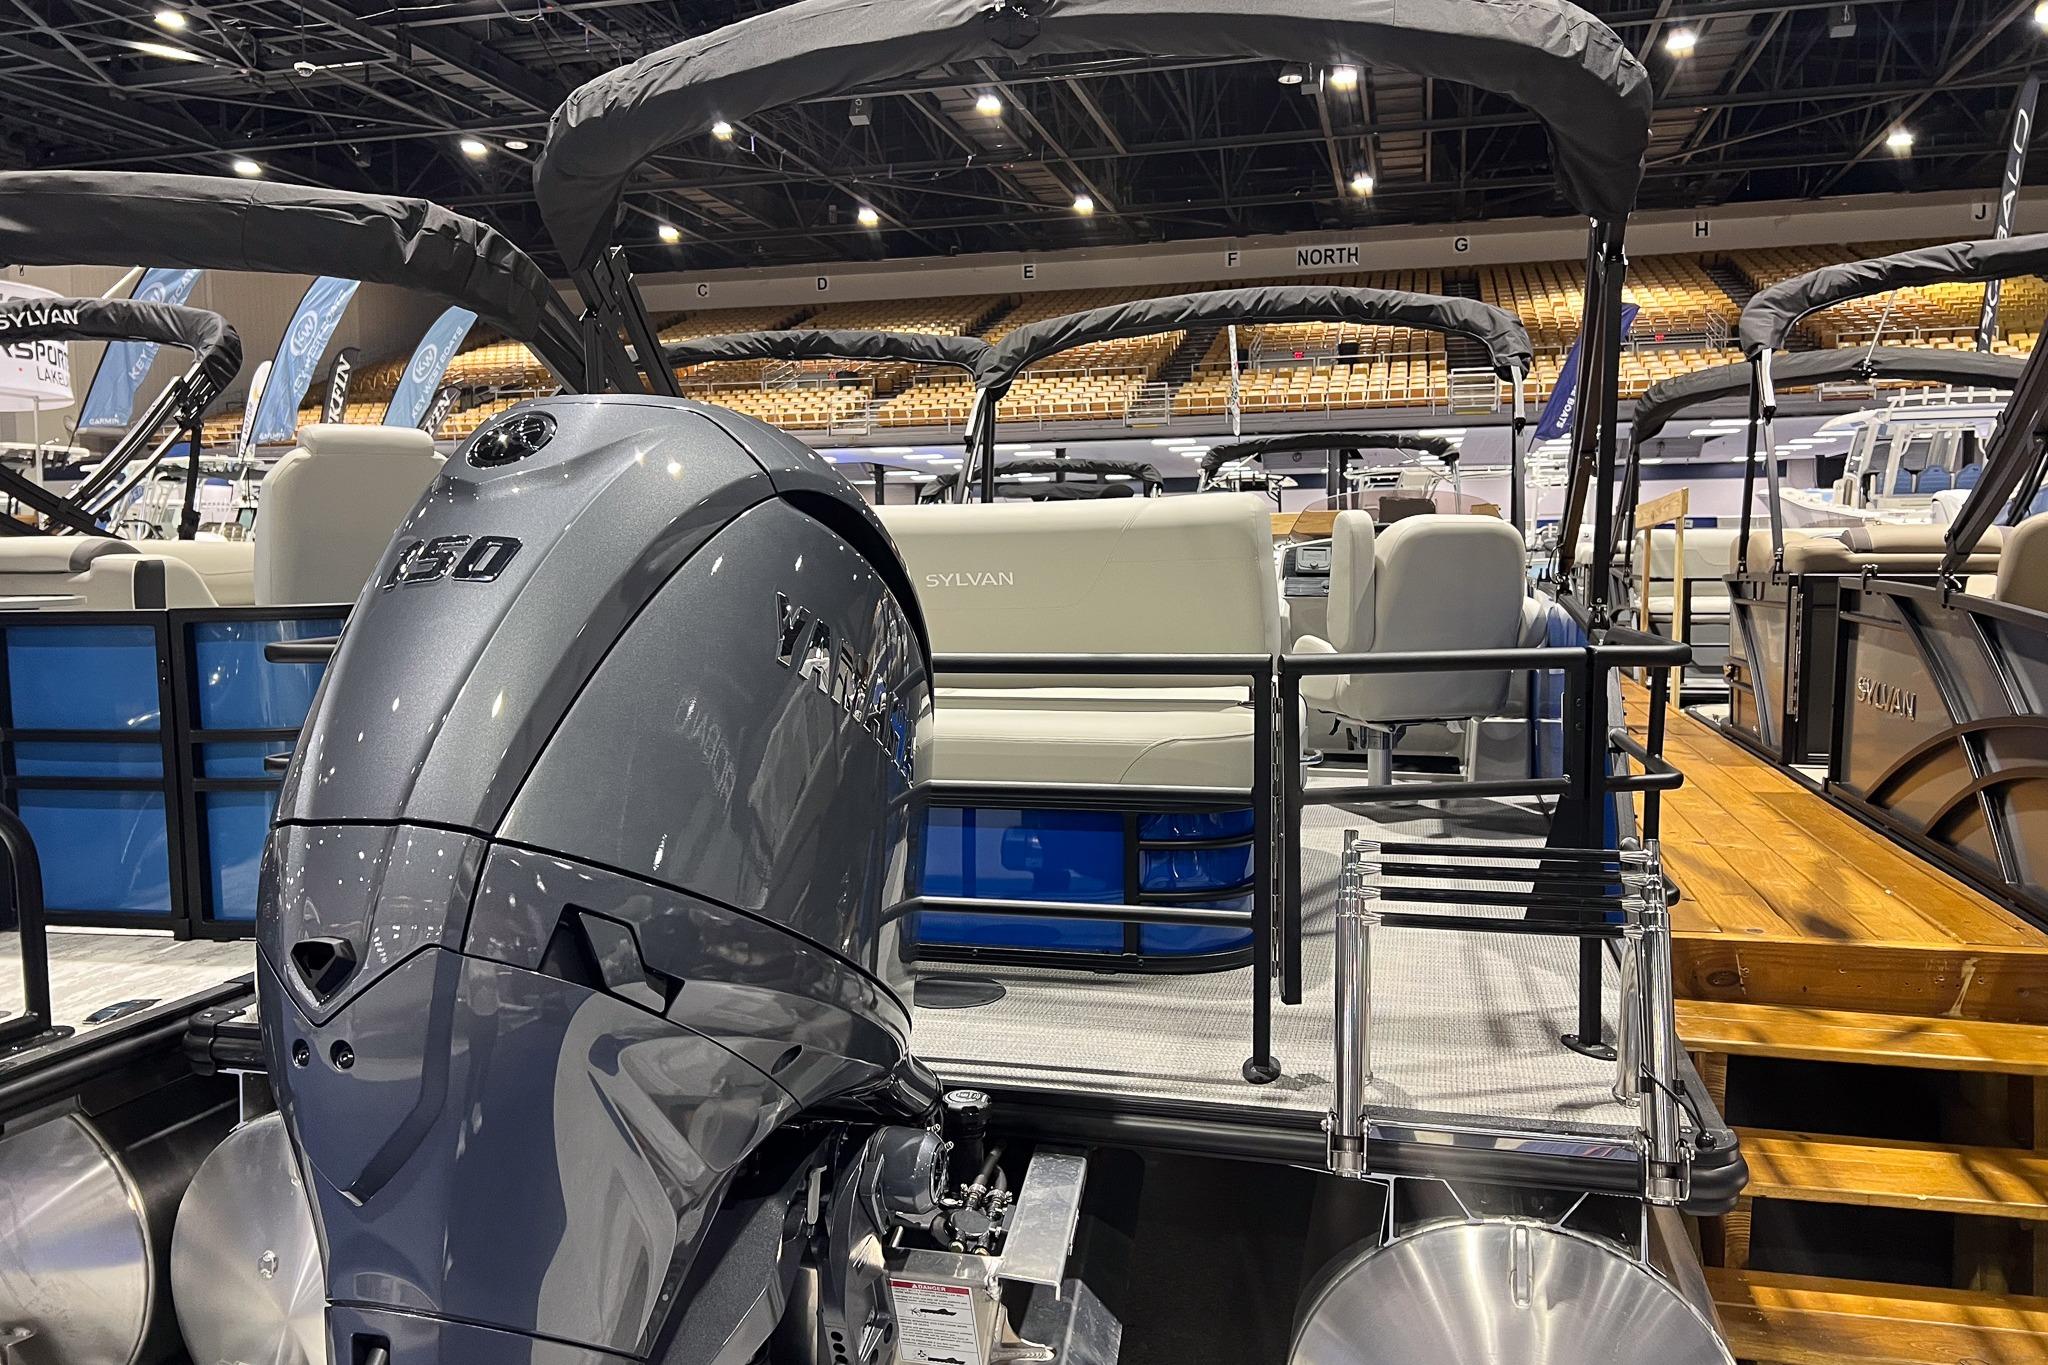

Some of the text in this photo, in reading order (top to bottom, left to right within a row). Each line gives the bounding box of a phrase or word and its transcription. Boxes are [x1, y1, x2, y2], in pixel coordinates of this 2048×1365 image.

[1975, 204, 1987, 220] J
[1695, 222, 1708, 237] H
[1454, 238, 1468, 252] G
[1228, 252, 1238, 266] F
[1297, 247, 1359, 266] NORTH
[1024, 265, 1034, 279] E
[697, 284, 708, 297] C
[817, 277, 828, 291] D
[0, 308, 79, 330] SYLVAN
[440, 326, 464, 363] BOATS
[383, 534, 523, 591] 150
[926, 572, 1014, 587] SYLVAN
[1857, 676, 1916, 720] SYLVAN
[918, 1284, 946, 1292] DANGER
